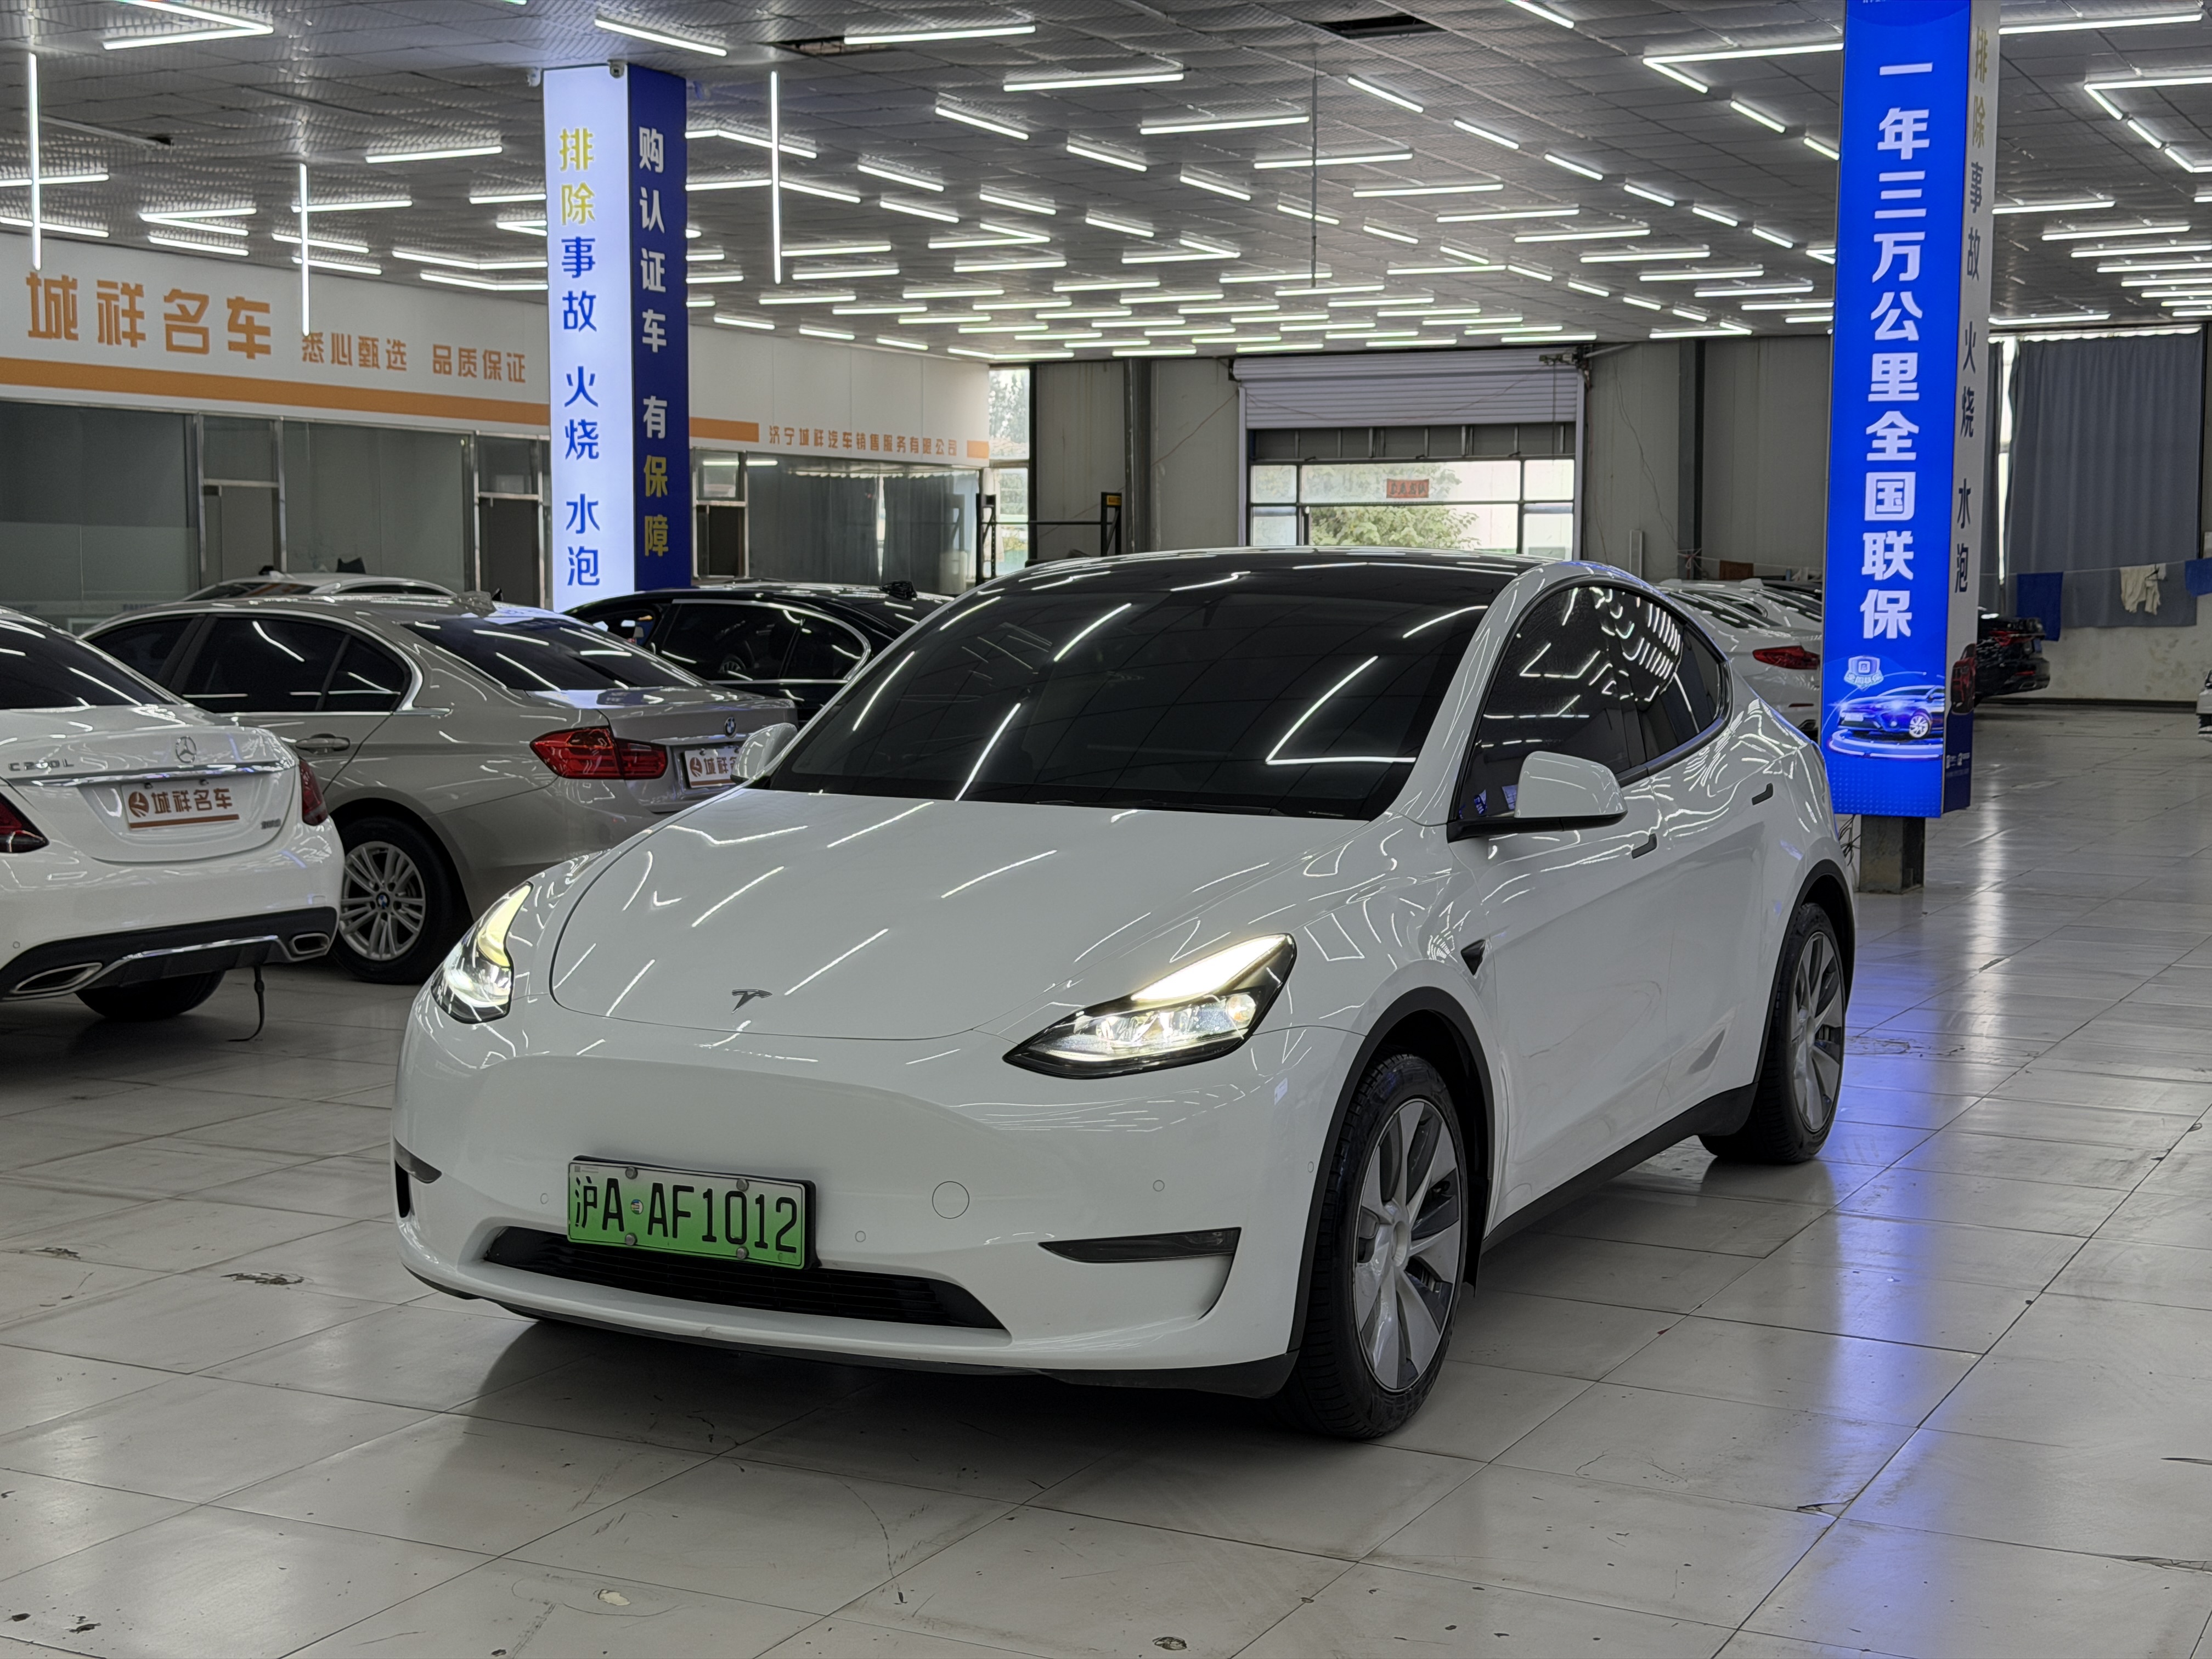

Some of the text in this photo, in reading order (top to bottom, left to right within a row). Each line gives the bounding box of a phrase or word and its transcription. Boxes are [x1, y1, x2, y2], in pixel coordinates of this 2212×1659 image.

[26, 271, 272, 360] 城祥名车
[639, 126, 669, 557] 购认证车 有保障
[1860, 63, 1933, 639] 一年三万公里全国联保
[1954, 26, 1988, 594] 排除事故 火烧 水泡
[302, 332, 526, 383] 悉心甄选 品质保证
[558, 127, 600, 587] 排除事故 火烧 水泡
[769, 425, 957, 456] 济宁城祥汽车销售服务有限公司
[8, 758, 74, 771] C20L
[151, 788, 233, 814] 城祥名车
